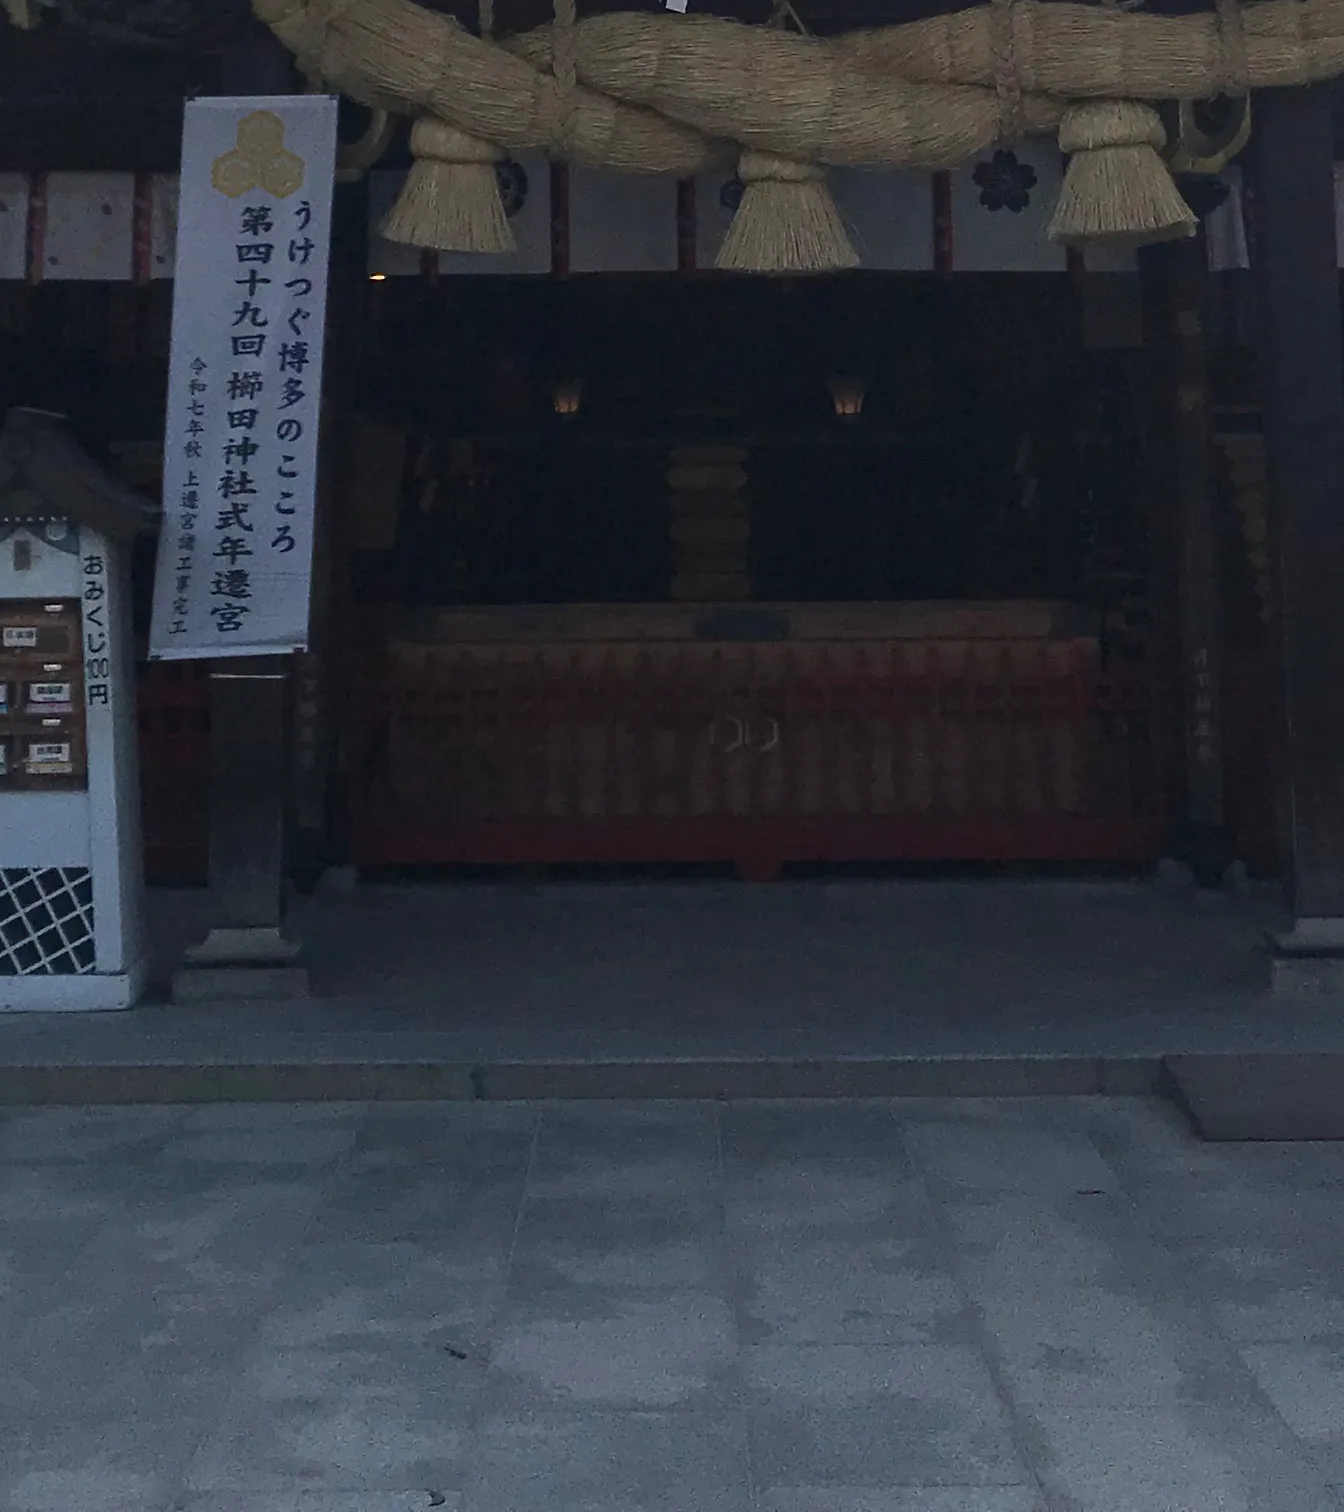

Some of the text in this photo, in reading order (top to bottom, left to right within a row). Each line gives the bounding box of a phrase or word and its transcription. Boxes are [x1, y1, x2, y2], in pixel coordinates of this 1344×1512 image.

[183, 356, 207, 459] 令和七年秋
[210, 205, 274, 634] 第四十九回櫛田神社式年遷宮
[270, 200, 316, 553] うけつぐ博多のこころ
